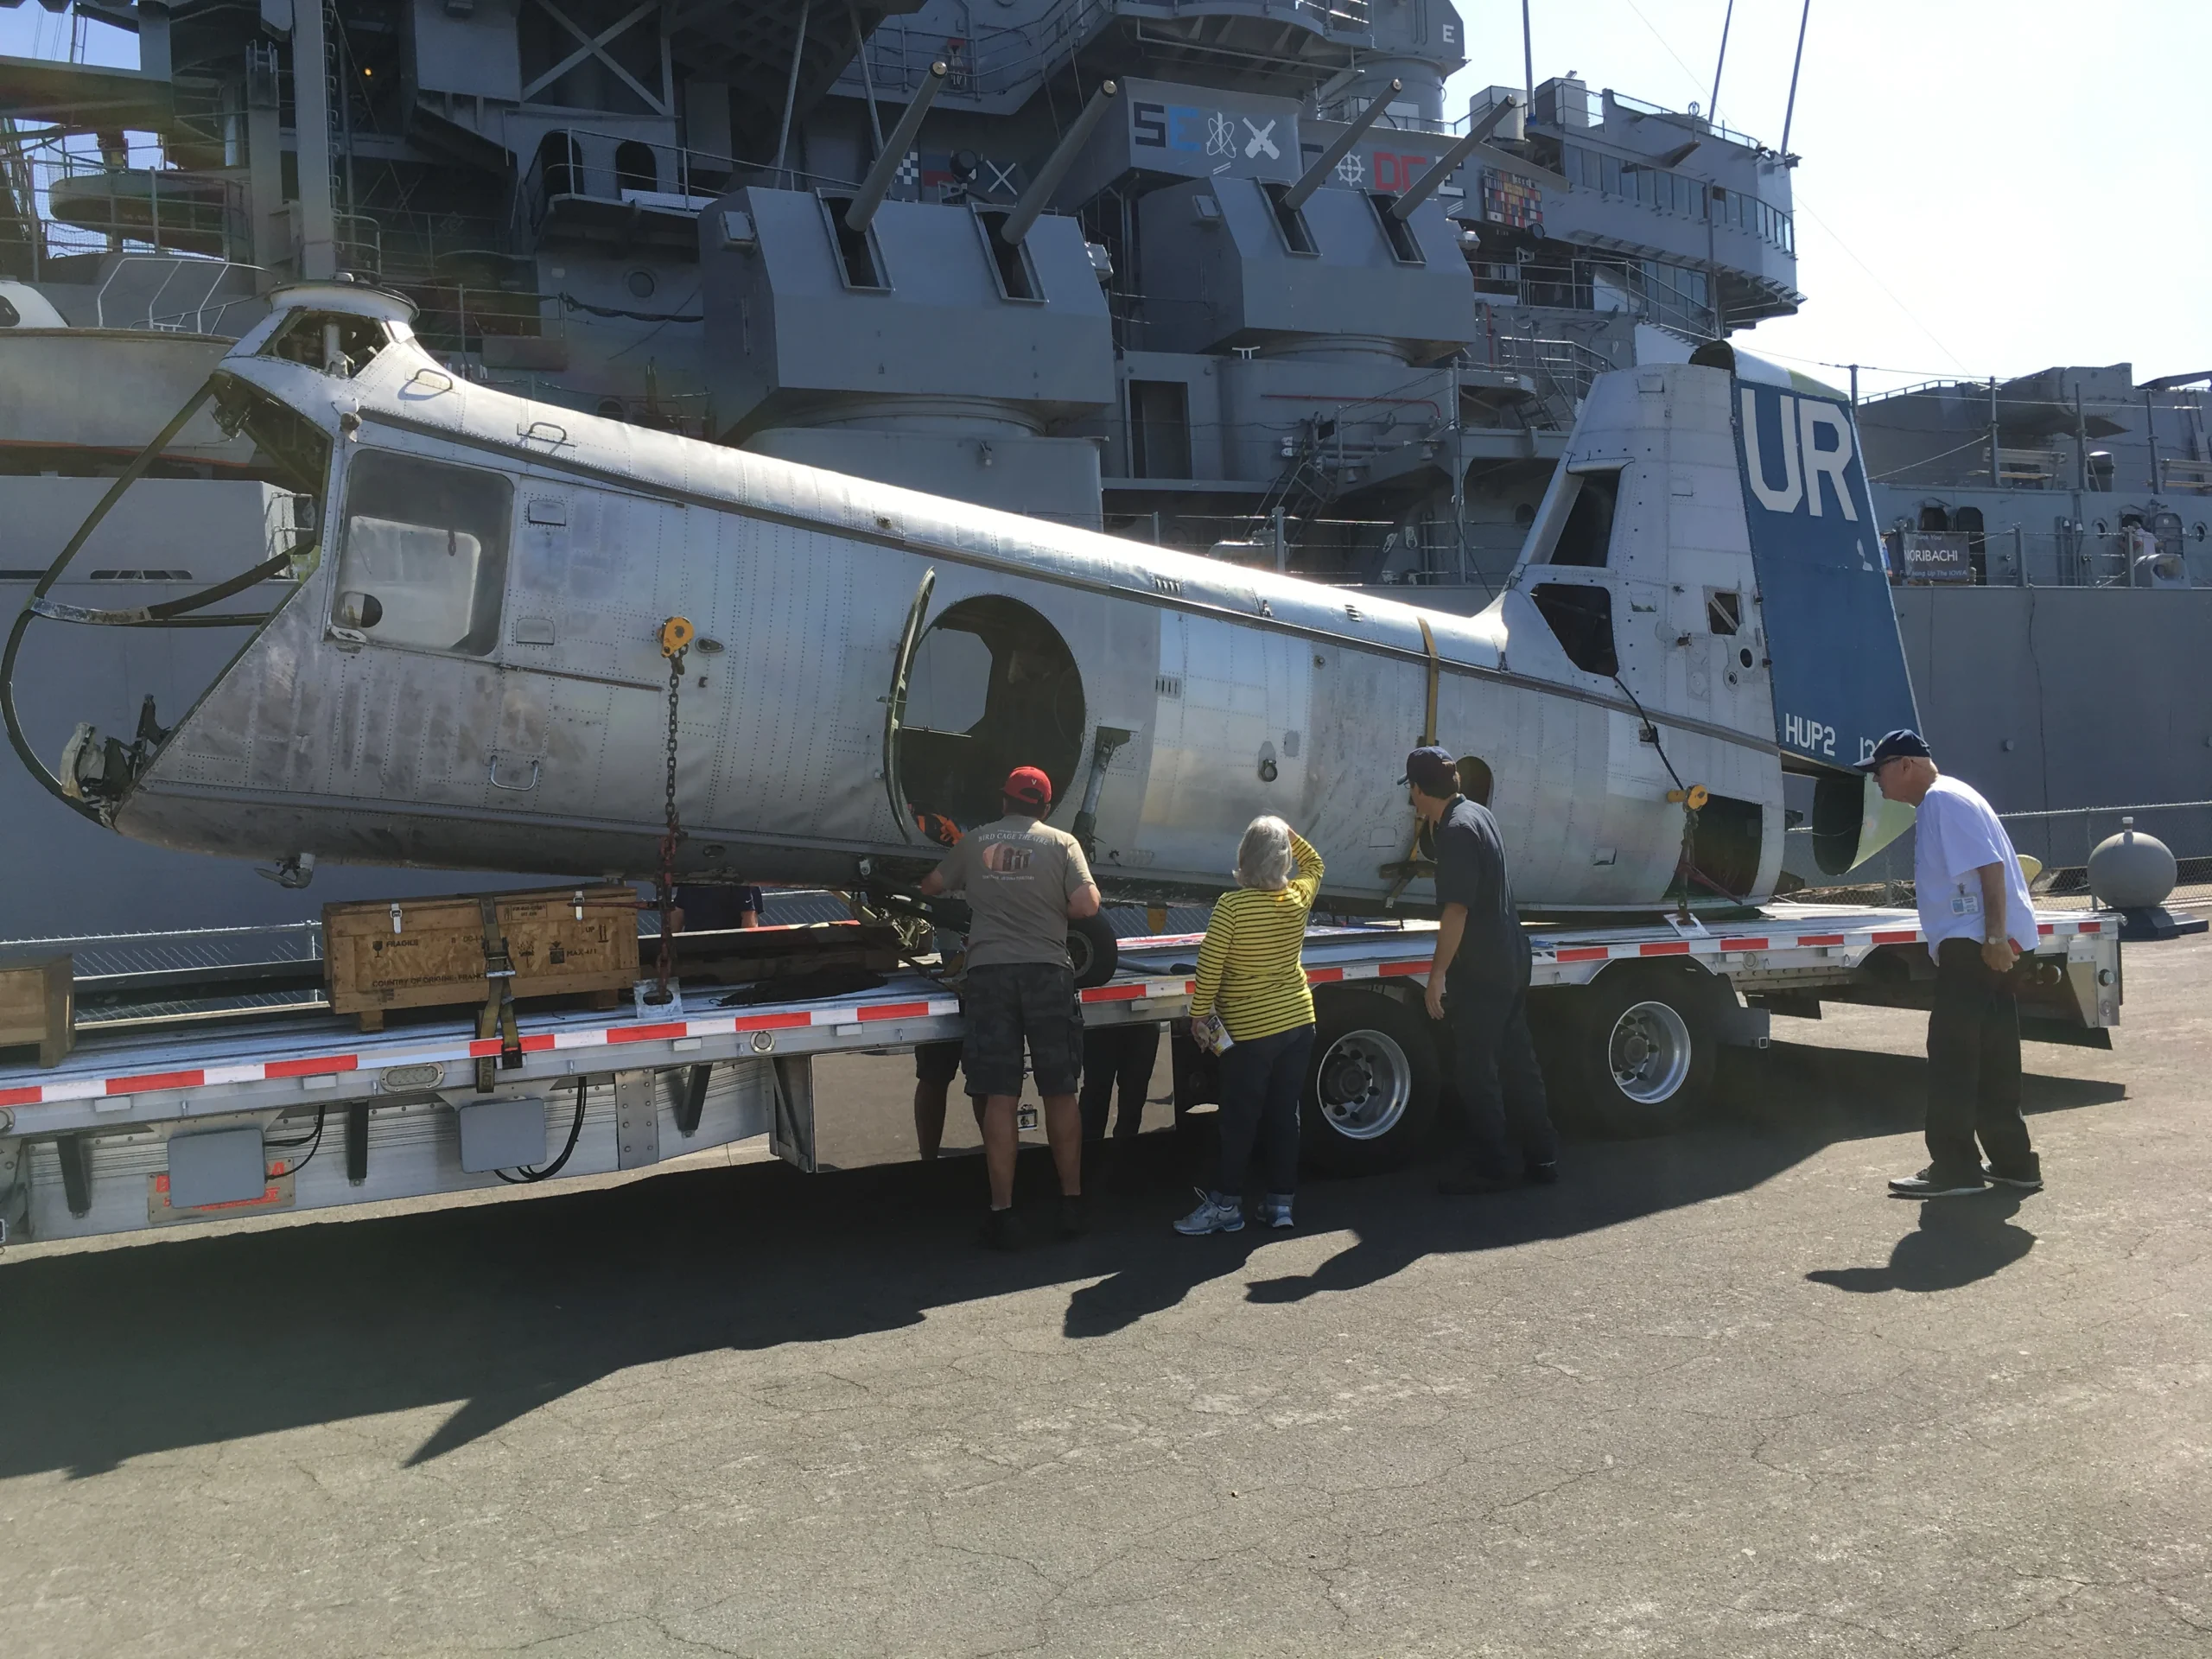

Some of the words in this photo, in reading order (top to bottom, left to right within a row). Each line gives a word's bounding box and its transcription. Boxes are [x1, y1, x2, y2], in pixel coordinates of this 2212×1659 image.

[1443, 24, 1454, 43] E
[1740, 387, 1858, 522] UR
[1904, 550, 1958, 562] NORIBACHI
[1785, 713, 1836, 757] HUP2
[978, 833, 995, 842] BIRD
[1018, 834, 1048, 846] THEATRE
[567, 949, 583, 957] MAX
